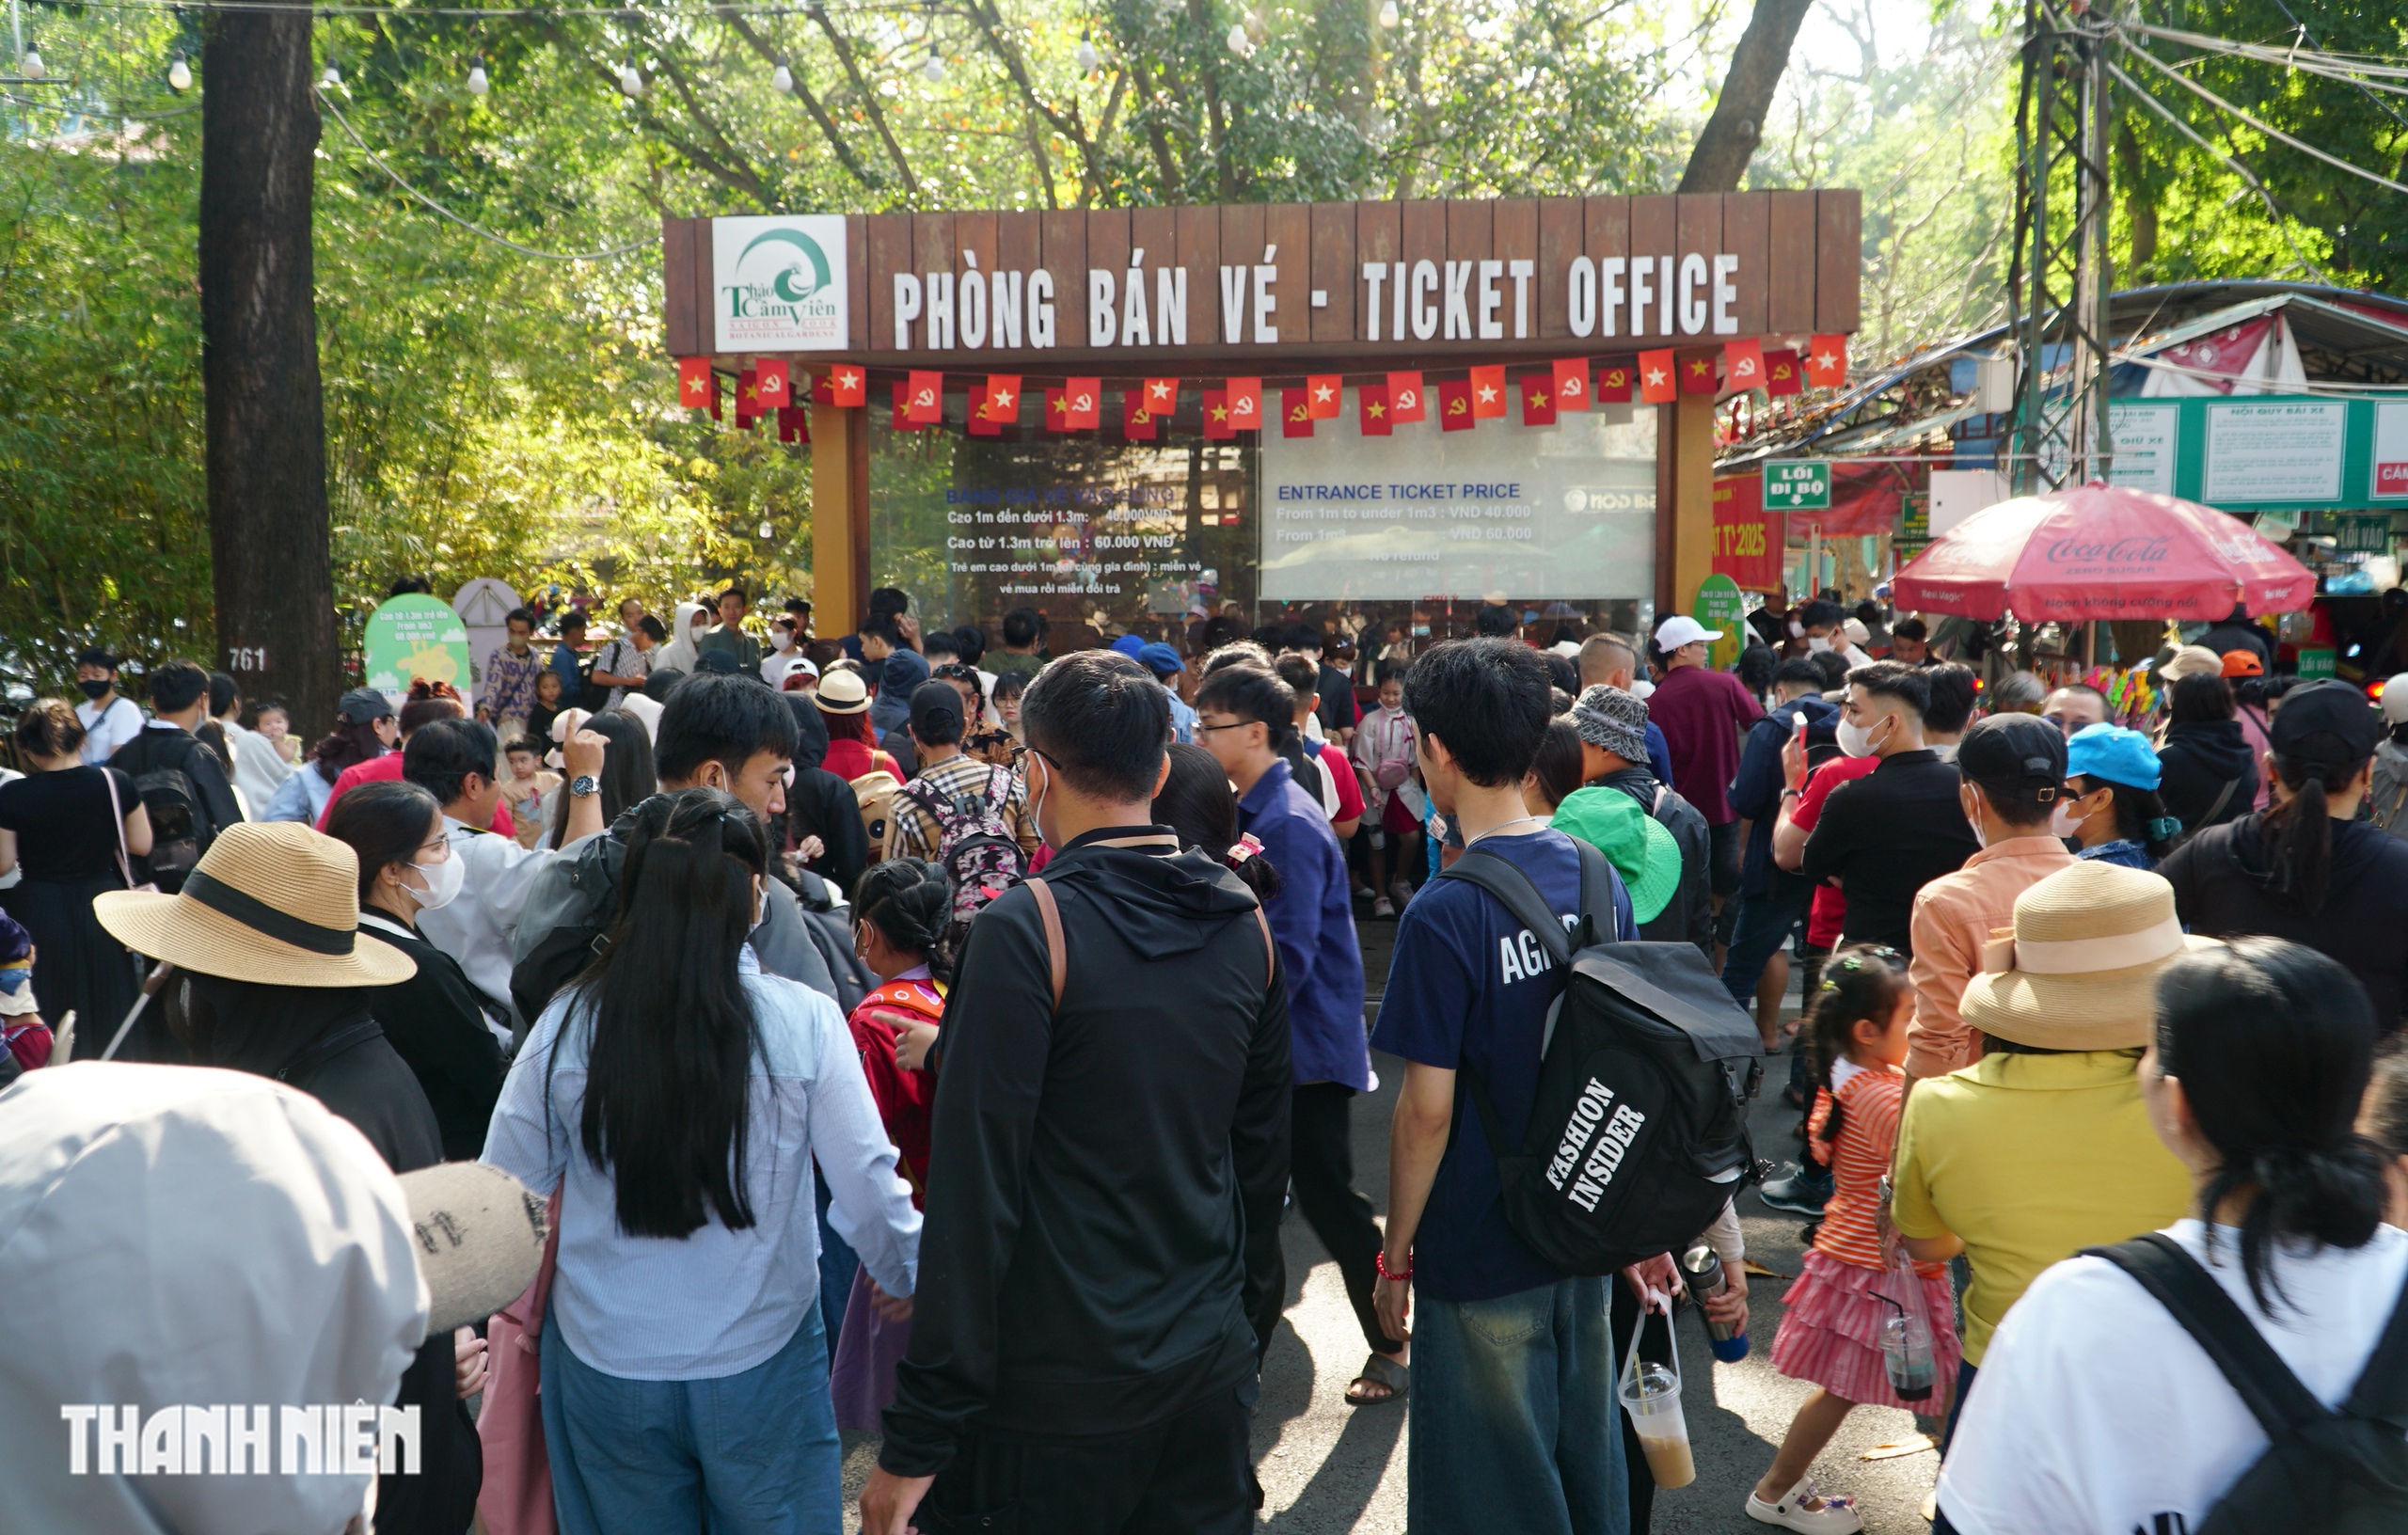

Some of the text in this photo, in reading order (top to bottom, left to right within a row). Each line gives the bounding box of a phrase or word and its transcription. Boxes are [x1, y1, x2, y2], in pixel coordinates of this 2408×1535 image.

[893, 244, 1739, 350] PHÒNG BÁN VÉ - TICKET OFFICE
[787, 299, 836, 326] Viên
[1782, 465, 1814, 480] LỐI
[1278, 483, 1521, 500] ENTRANCE TICKET PRICE
[1770, 480, 1825, 496] ĐI BỘ
[947, 511, 973, 523] Cao
[975, 511, 994, 523] 1m
[996, 508, 1021, 523] đến
[1022, 510, 1053, 523] dưới
[1055, 511, 1088, 523] 1.3m:
[1276, 508, 1314, 520] From
[1319, 508, 1339, 519] 1m
[1342, 508, 1357, 519] to
[1361, 507, 1402, 519] under
[1407, 506, 1436, 519] 1m3
[1450, 506, 1481, 518] VND
[1484, 505, 1531, 518] 40.000
[947, 536, 975, 549] Cao
[979, 535, 995, 549] từ
[998, 536, 1032, 549] 1.3m
[1035, 536, 1056, 549] trở
[1059, 535, 1081, 549] lên
[1095, 536, 1140, 549] 60.000
[1143, 535, 1175, 548] VNĐ
[1276, 529, 1313, 542] From
[1450, 528, 1482, 540] VND
[1486, 527, 1532, 540] 60.000
[1735, 522, 1766, 557] 2025
[1394, 549, 1440, 562] refund
[2047, 535, 2174, 563] Coca-Cola
[951, 562, 968, 572] Trẻ
[970, 563, 987, 573] em
[989, 563, 1008, 573] cao
[1011, 562, 1038, 573] dưới
[1104, 562, 1121, 574] gia
[1015, 585, 1038, 594] mua
[1057, 581, 1083, 594] miễn
[1922, 589, 1937, 600] Real
[2045, 597, 2081, 609] Ngon
[2083, 596, 2126, 609] không
[228, 646, 264, 672] 761
[1545, 1077, 1615, 1192] FASHION
[1568, 1103, 1646, 1213] INSIDER
